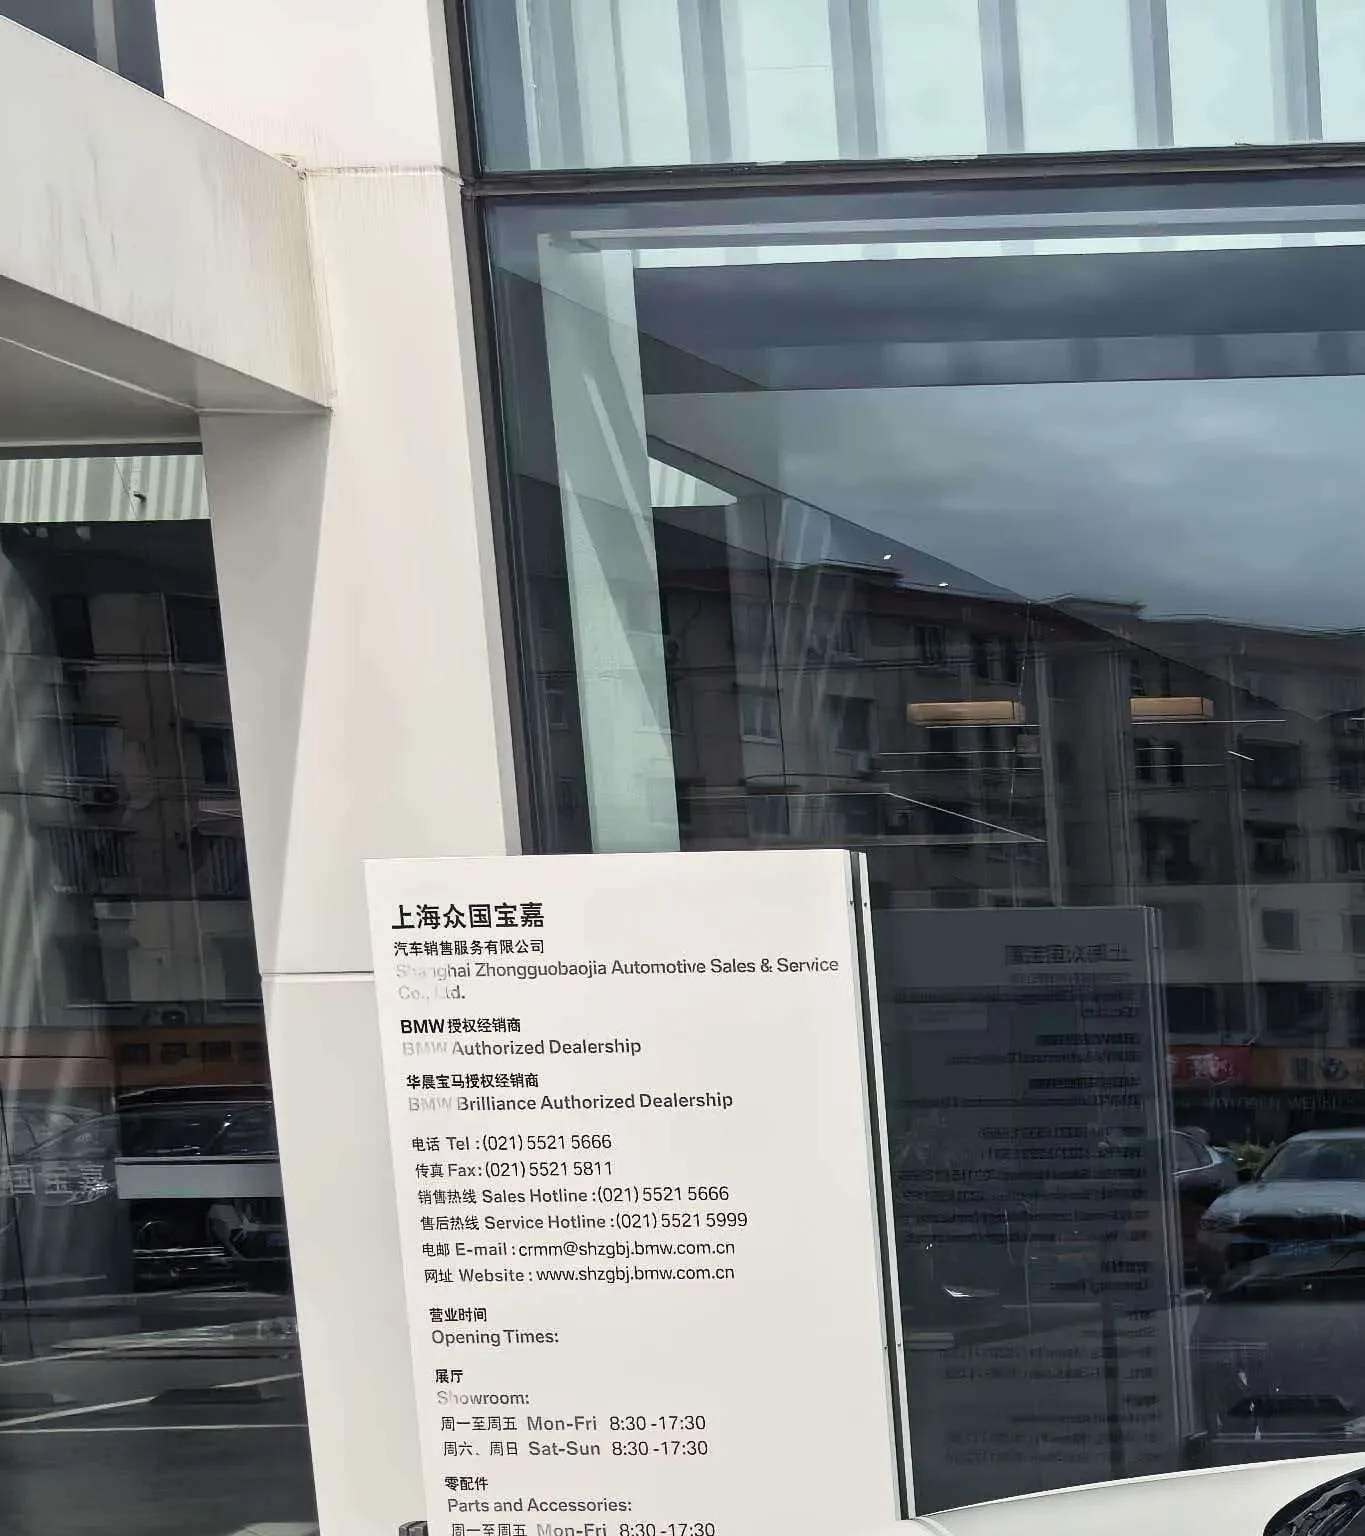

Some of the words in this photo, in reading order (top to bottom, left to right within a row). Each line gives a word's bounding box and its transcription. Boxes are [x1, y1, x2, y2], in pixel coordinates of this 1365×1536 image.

[392, 902, 544, 929] 上海众国宝嘉
[394, 937, 544, 957] 汽车销售服务有限公司
[474, 958, 608, 979] Zhongguobaojia
[611, 959, 706, 976] Automotive
[710, 958, 757, 973] Sales
[760, 958, 773, 973] &
[777, 957, 838, 972] Service
[402, 1041, 449, 1057] BMW
[453, 1040, 544, 1055] Authorized
[549, 1038, 641, 1056] Dealership
[406, 1072, 538, 1090] 华晨宝马授权经销商
[408, 1096, 452, 1112] BMW
[456, 1096, 536, 1111] Brilliance
[541, 1094, 635, 1111] Authorized
[640, 1092, 732, 1109] Dealership
[412, 1136, 440, 1152] 电话
[445, 1136, 469, 1150] Tel
[527, 1135, 564, 1151] 5521
[570, 1135, 611, 1151] 5666
[416, 1162, 444, 1179] 传真
[529, 1162, 568, 1176] 5521
[574, 1161, 611, 1175] 5811
[417, 1188, 479, 1206] 销售热线
[482, 1189, 525, 1204] Sales
[530, 1188, 587, 1202] Hotline
[643, 1187, 681, 1201] 5521
[688, 1185, 729, 1200] 5666
[420, 1215, 480, 1232] 售后热线
[485, 1216, 543, 1229] Service
[548, 1214, 606, 1228] Hotline
[661, 1211, 699, 1229] 5521
[706, 1210, 747, 1227] 5999
[422, 1241, 450, 1257] 电邮
[456, 1242, 507, 1256] E-mail
[519, 1240, 734, 1261] crmm@shzgbj.bmw.com.cn
[424, 1268, 455, 1283] 网址
[459, 1266, 525, 1282] Website
[536, 1264, 734, 1283] www.shzgbj.bmw.com.cn
[429, 1306, 487, 1322] 营业时间
[432, 1328, 500, 1347] Opening
[503, 1329, 558, 1343] Times:
[434, 1369, 463, 1384] 展厅
[435, 1389, 531, 1407] Showroom:
[441, 1416, 517, 1431] 周一至周五
[527, 1416, 596, 1431] Mon-Fri
[608, 1416, 646, 1431] 8:30
[442, 1440, 518, 1456] 周六、周日
[528, 1441, 600, 1456] Sat-Sun
[610, 1440, 648, 1456] 8:30
[445, 1476, 488, 1492] 零配件
[448, 1499, 489, 1512] Parts
[494, 1498, 523, 1512] and
[527, 1498, 632, 1512] Accessories:
